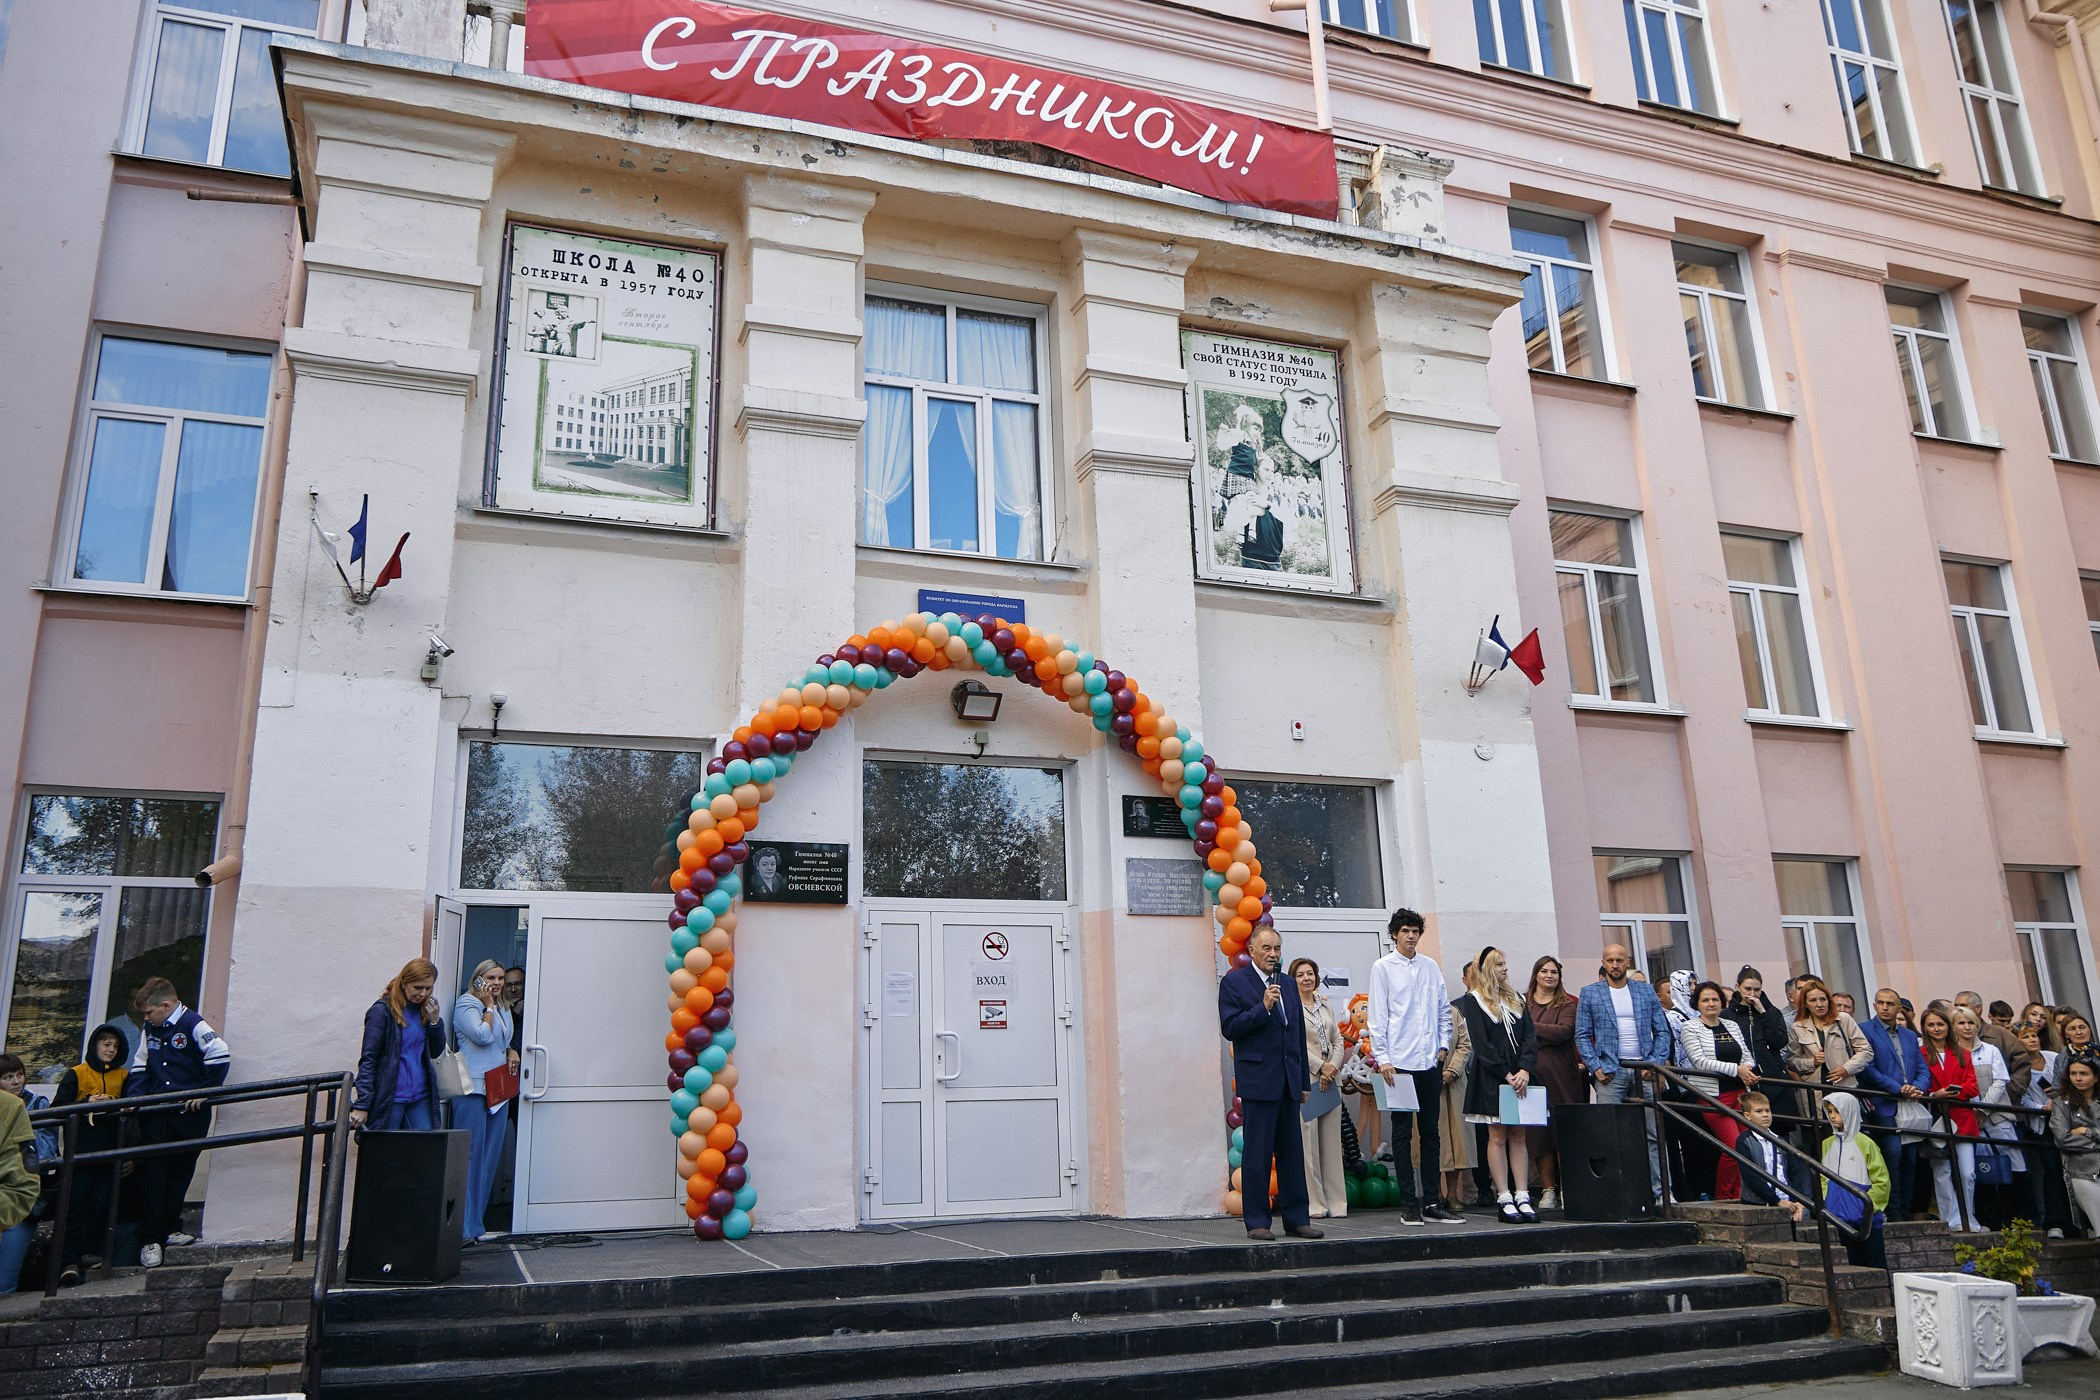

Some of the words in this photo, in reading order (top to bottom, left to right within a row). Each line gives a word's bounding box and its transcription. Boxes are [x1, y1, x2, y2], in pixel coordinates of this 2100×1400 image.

[642, 17, 697, 72] С
[711, 29, 1266, 177] ПРАЗДНИКОМ!
[552, 249, 636, 274] ШКОЛА
[656, 263, 705, 283] №40
[520, 266, 589, 285] ОТКРЫТА
[600, 278, 608, 287] В
[620, 279, 657, 296] 1957
[667, 286, 705, 300] ГОДУ
[621, 307, 667, 320] Второе
[618, 319, 670, 331] сентября
[1212, 342, 1285, 363] ГИМНАЗИЯ
[1288, 354, 1314, 367] №40
[1192, 352, 1223, 365] СВОЙ
[1226, 357, 1268, 371] СТАТУС
[1270, 364, 1328, 380] ПОЛУЧИЛА
[1229, 369, 1236, 378] В
[1240, 370, 1266, 382] 1992
[1270, 375, 1298, 387] ГОДУ
[1315, 432, 1330, 443] 40
[788, 883, 843, 892] ОВСИЕВСКОЙ
[976, 976, 1006, 986] ВХОД
